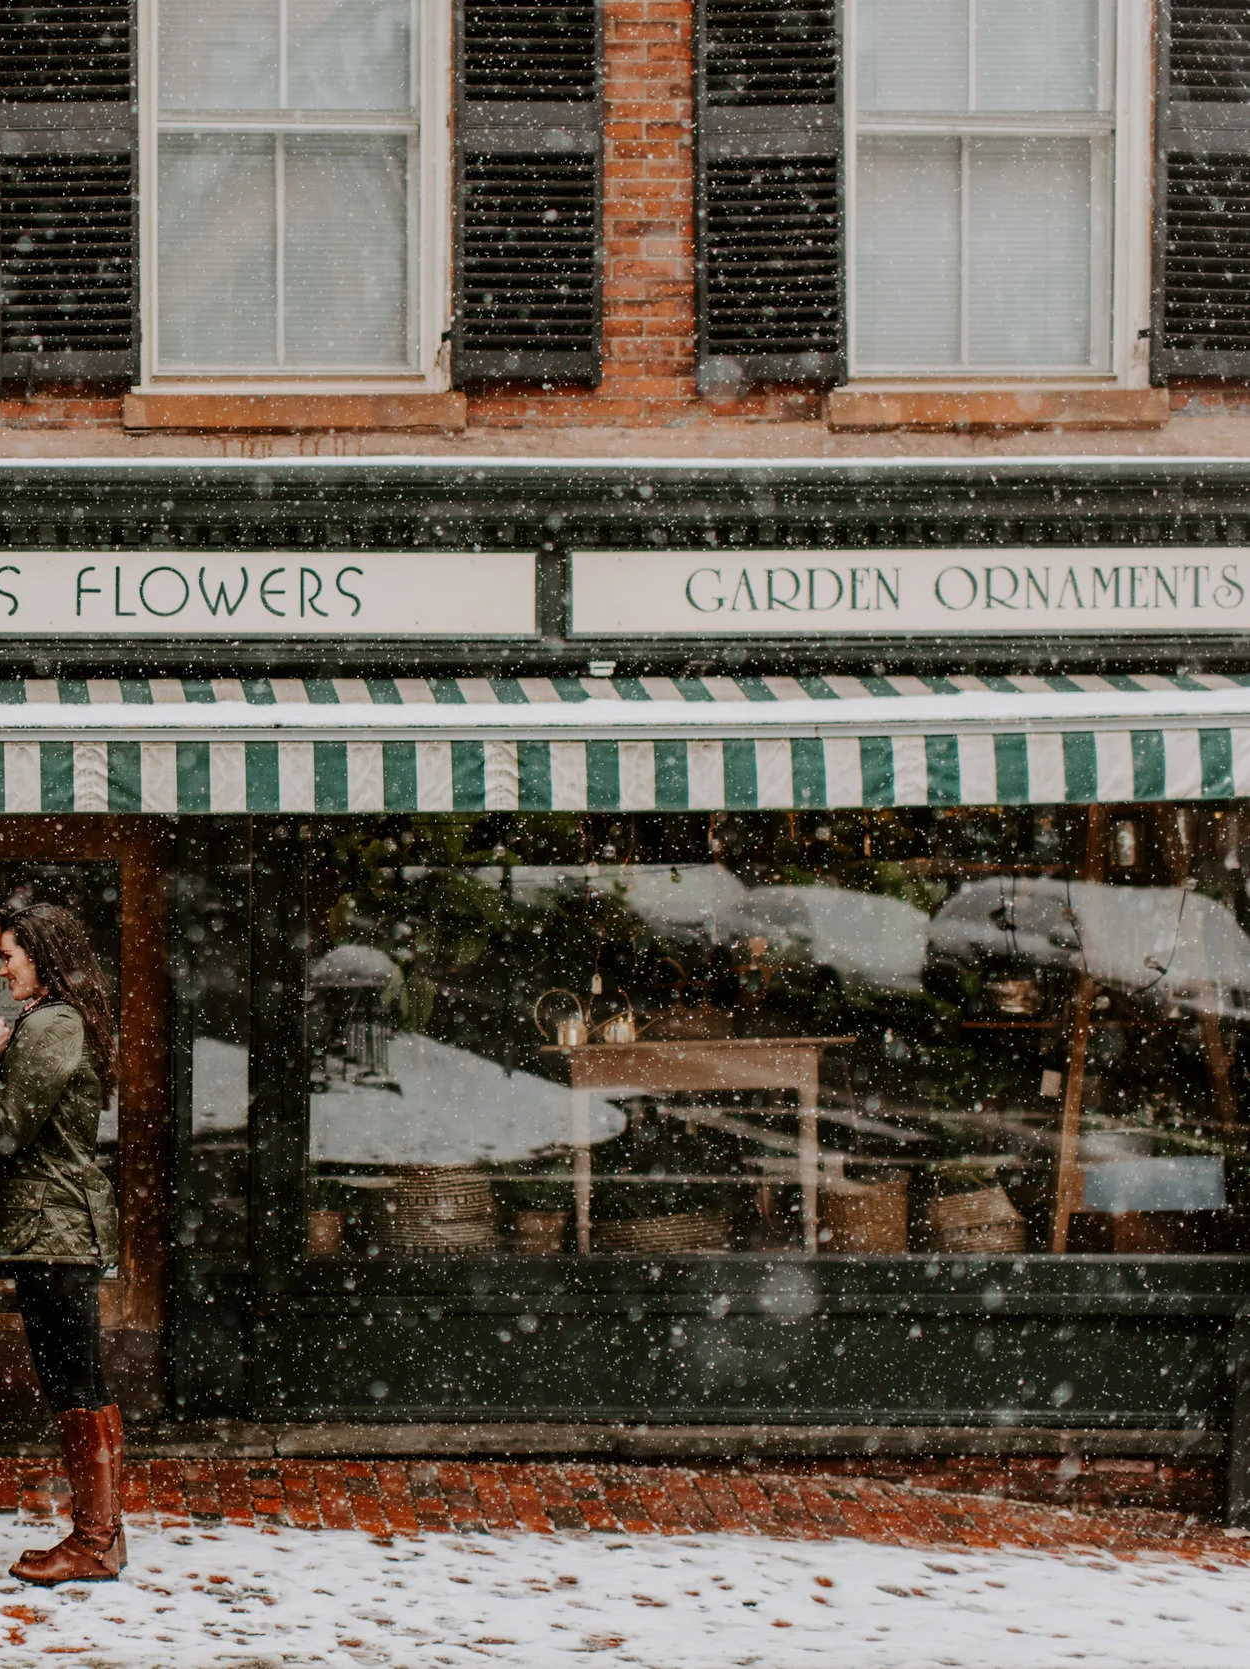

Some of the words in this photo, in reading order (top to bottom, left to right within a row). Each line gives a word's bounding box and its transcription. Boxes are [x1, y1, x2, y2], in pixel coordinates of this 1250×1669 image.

[76, 565, 364, 618] FLOWERS
[685, 566, 900, 613] GARDEN
[934, 563, 1245, 613] ORNAMENTS
